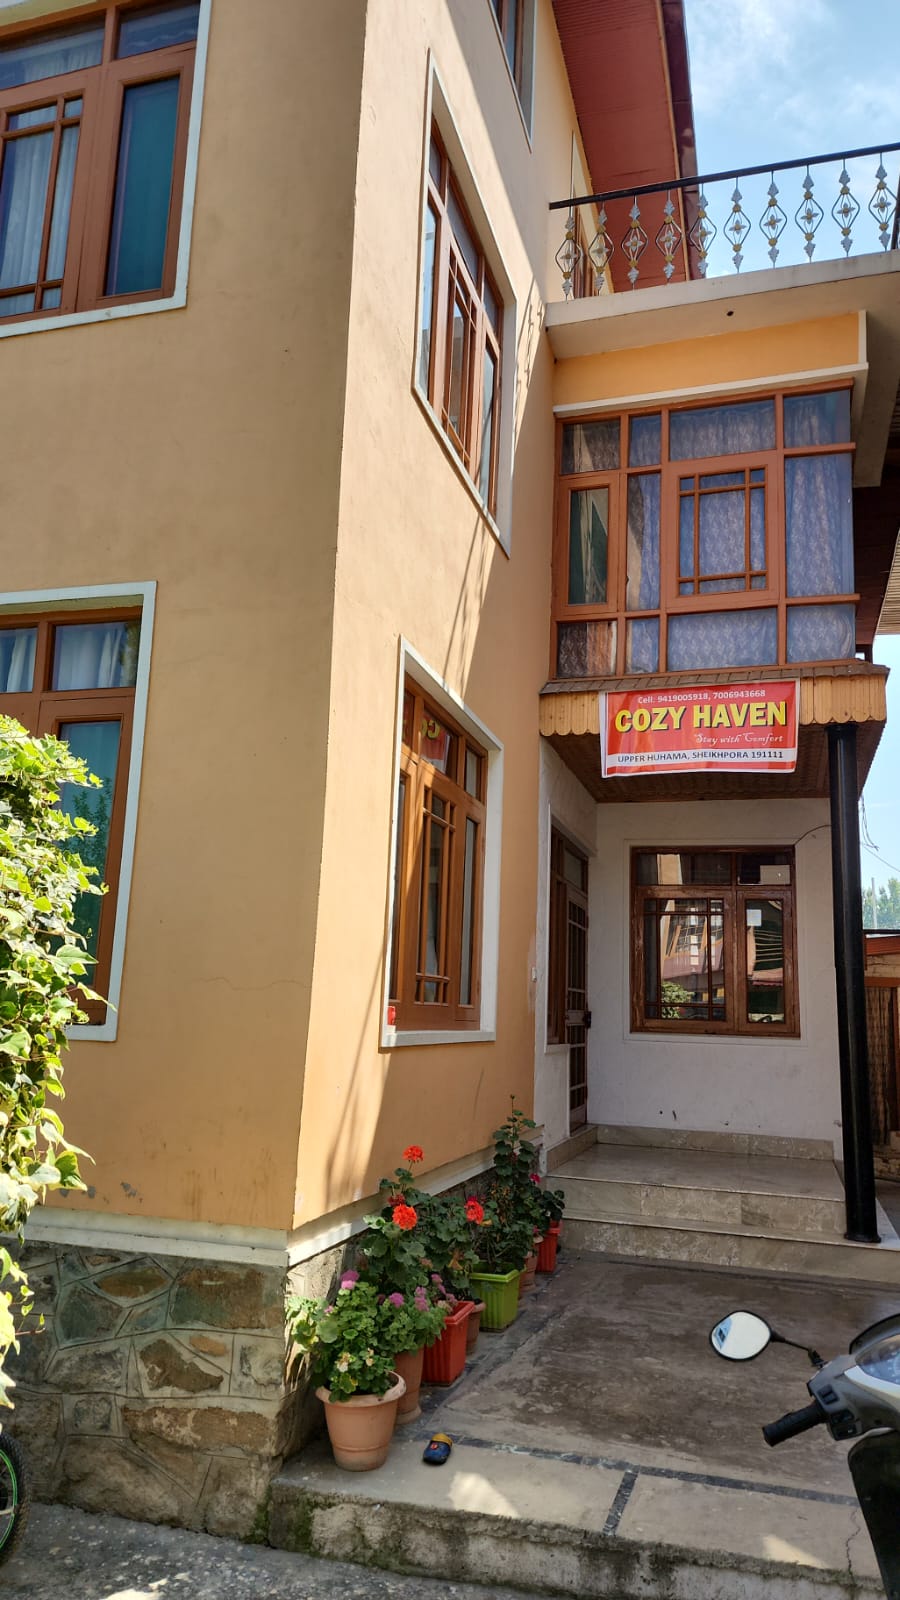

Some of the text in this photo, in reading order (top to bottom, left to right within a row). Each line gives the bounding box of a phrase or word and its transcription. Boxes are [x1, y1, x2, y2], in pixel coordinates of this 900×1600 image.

[712, 690, 766, 700] 7006943668
[615, 701, 786, 732] COZY HAVEN
[694, 732, 784, 747] Stay with Comfort
[617, 751, 783, 763] UPPER HUHAMA, SHEIKHPORA 191111
